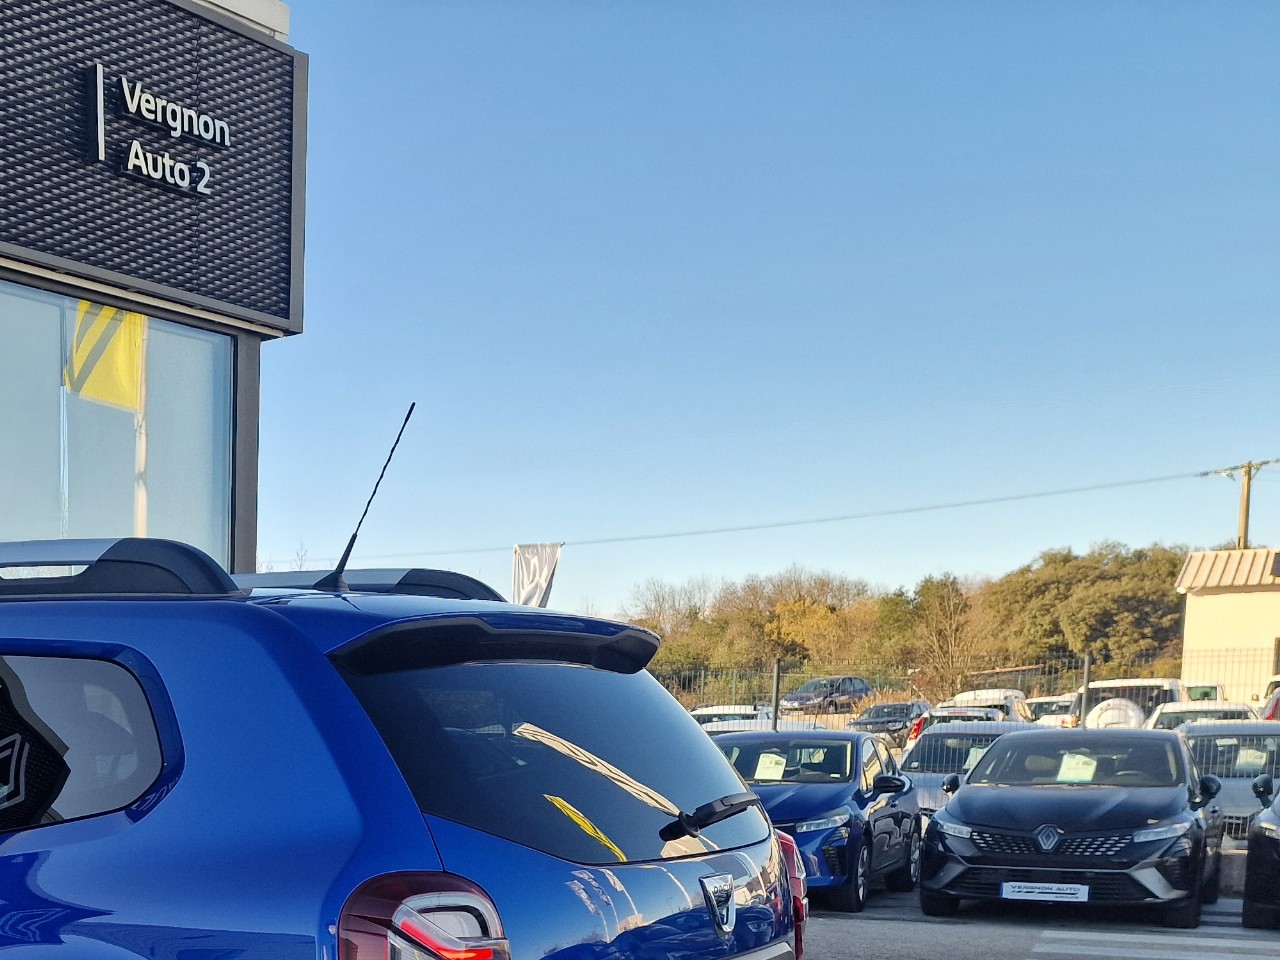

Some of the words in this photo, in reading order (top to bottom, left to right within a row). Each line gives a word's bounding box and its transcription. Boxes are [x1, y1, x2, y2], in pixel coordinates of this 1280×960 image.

[121, 76, 231, 146] Vergnon
[127, 140, 190, 188] Auto
[196, 161, 212, 195] 2
